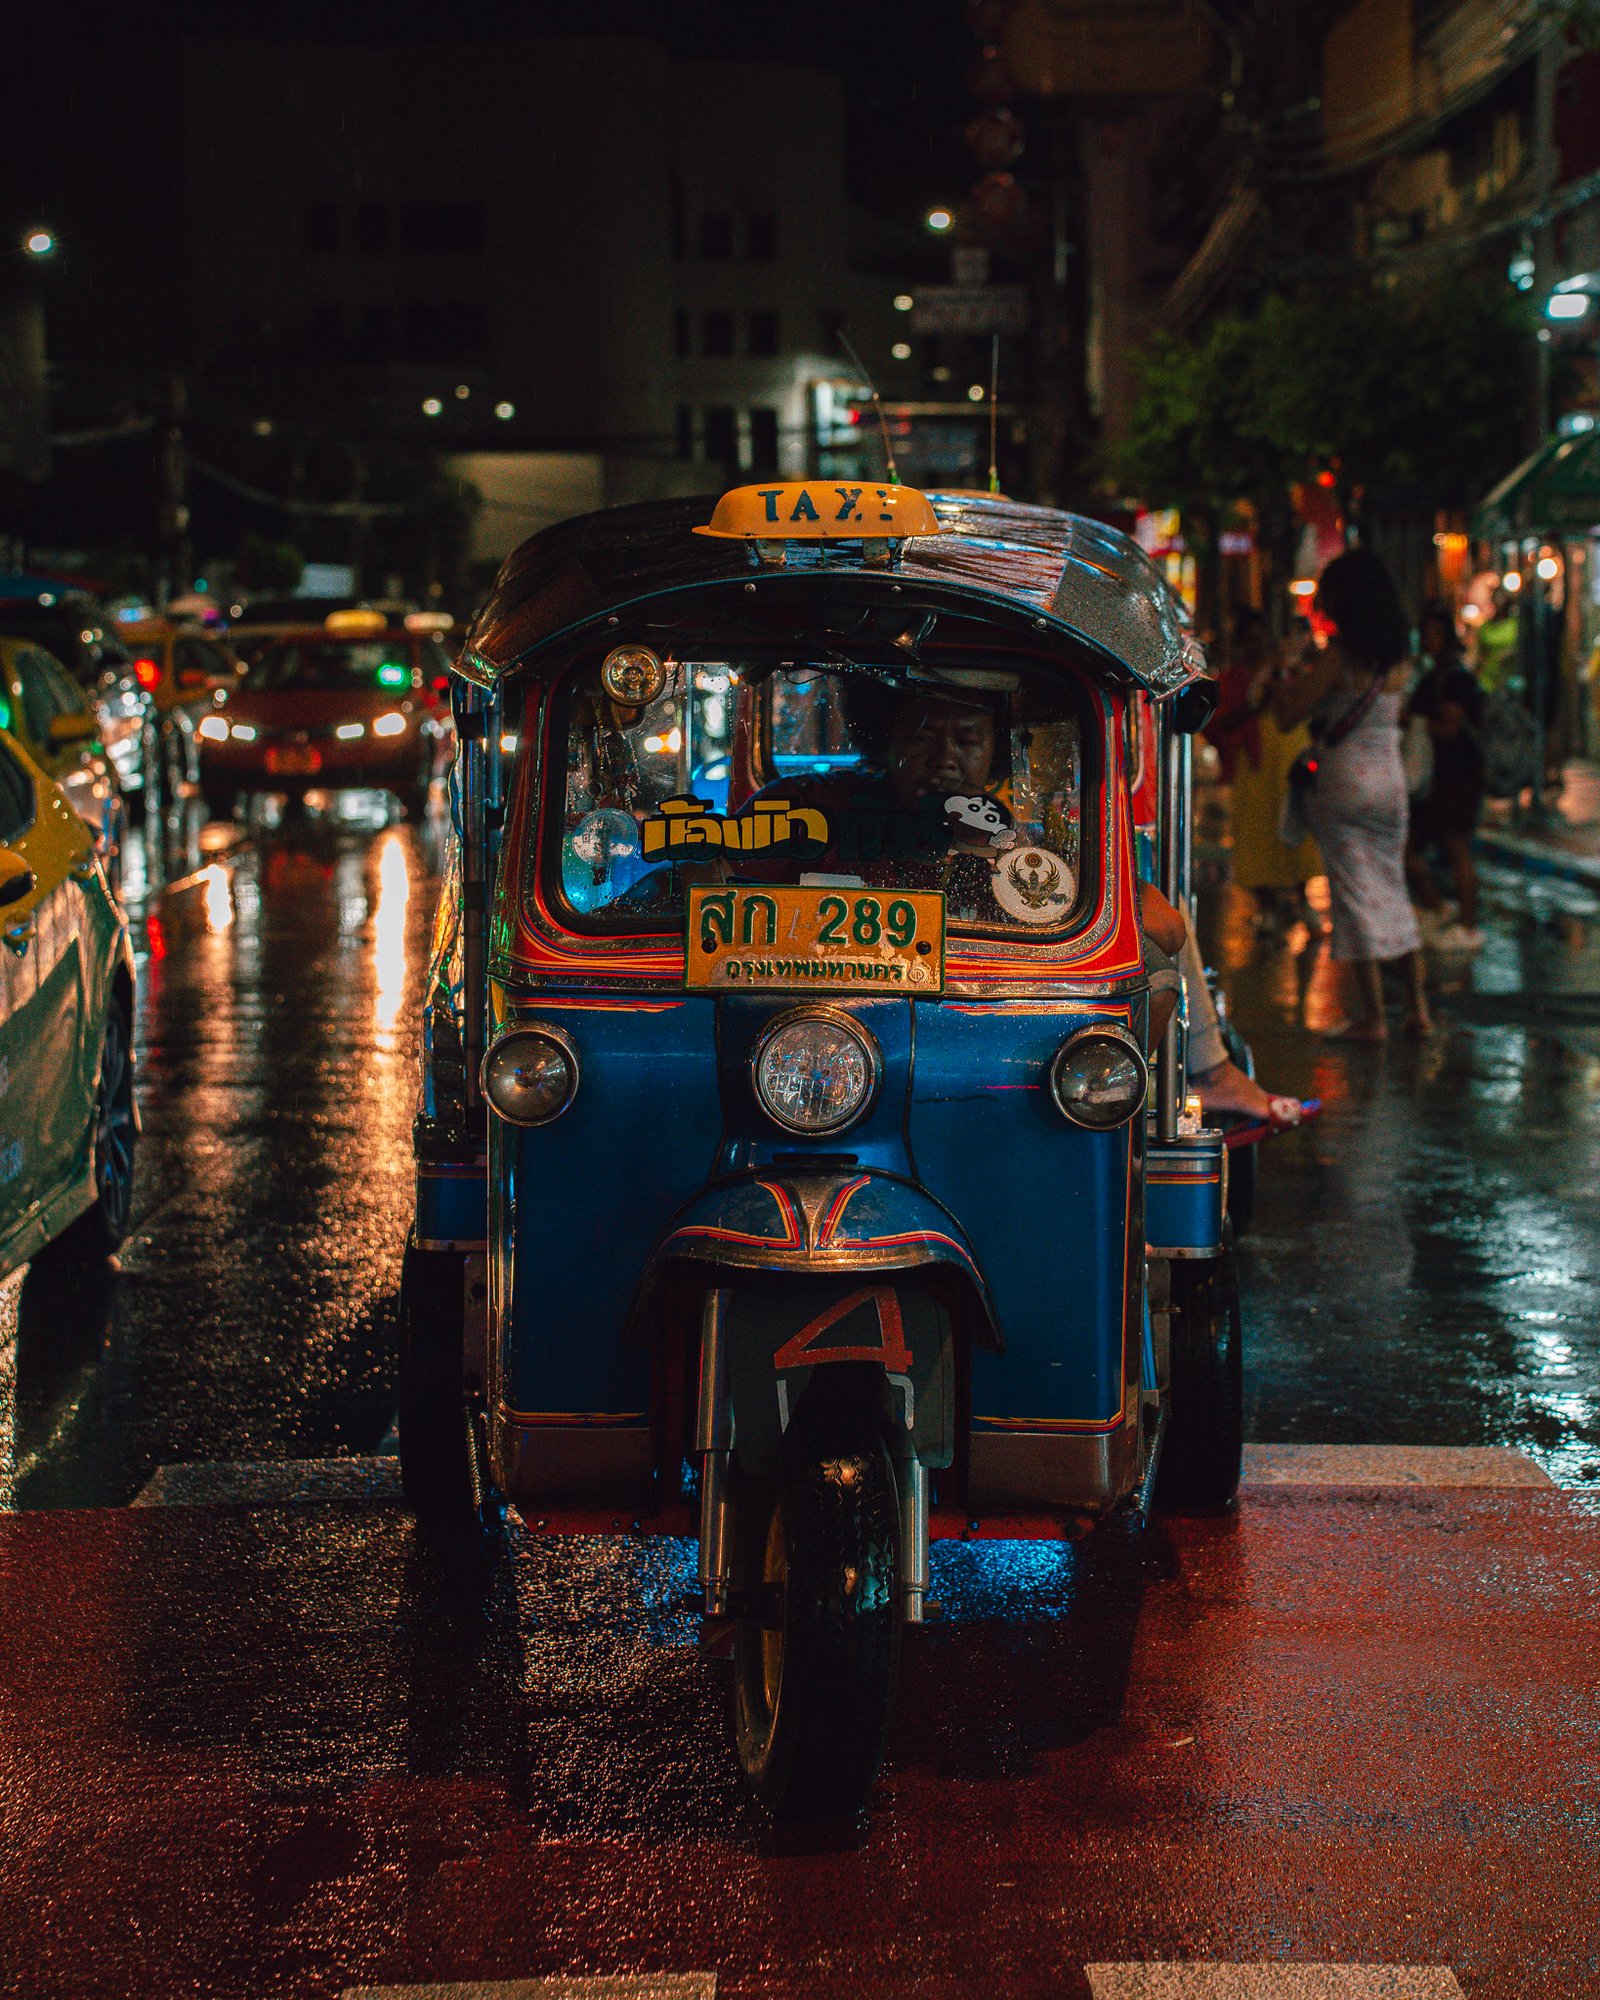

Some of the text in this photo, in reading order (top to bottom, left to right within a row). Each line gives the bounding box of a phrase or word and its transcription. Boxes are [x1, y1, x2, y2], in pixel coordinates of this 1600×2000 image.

[700, 889, 918, 949] สก 289
[725, 958, 905, 984] กรุงเทพมหานคร
